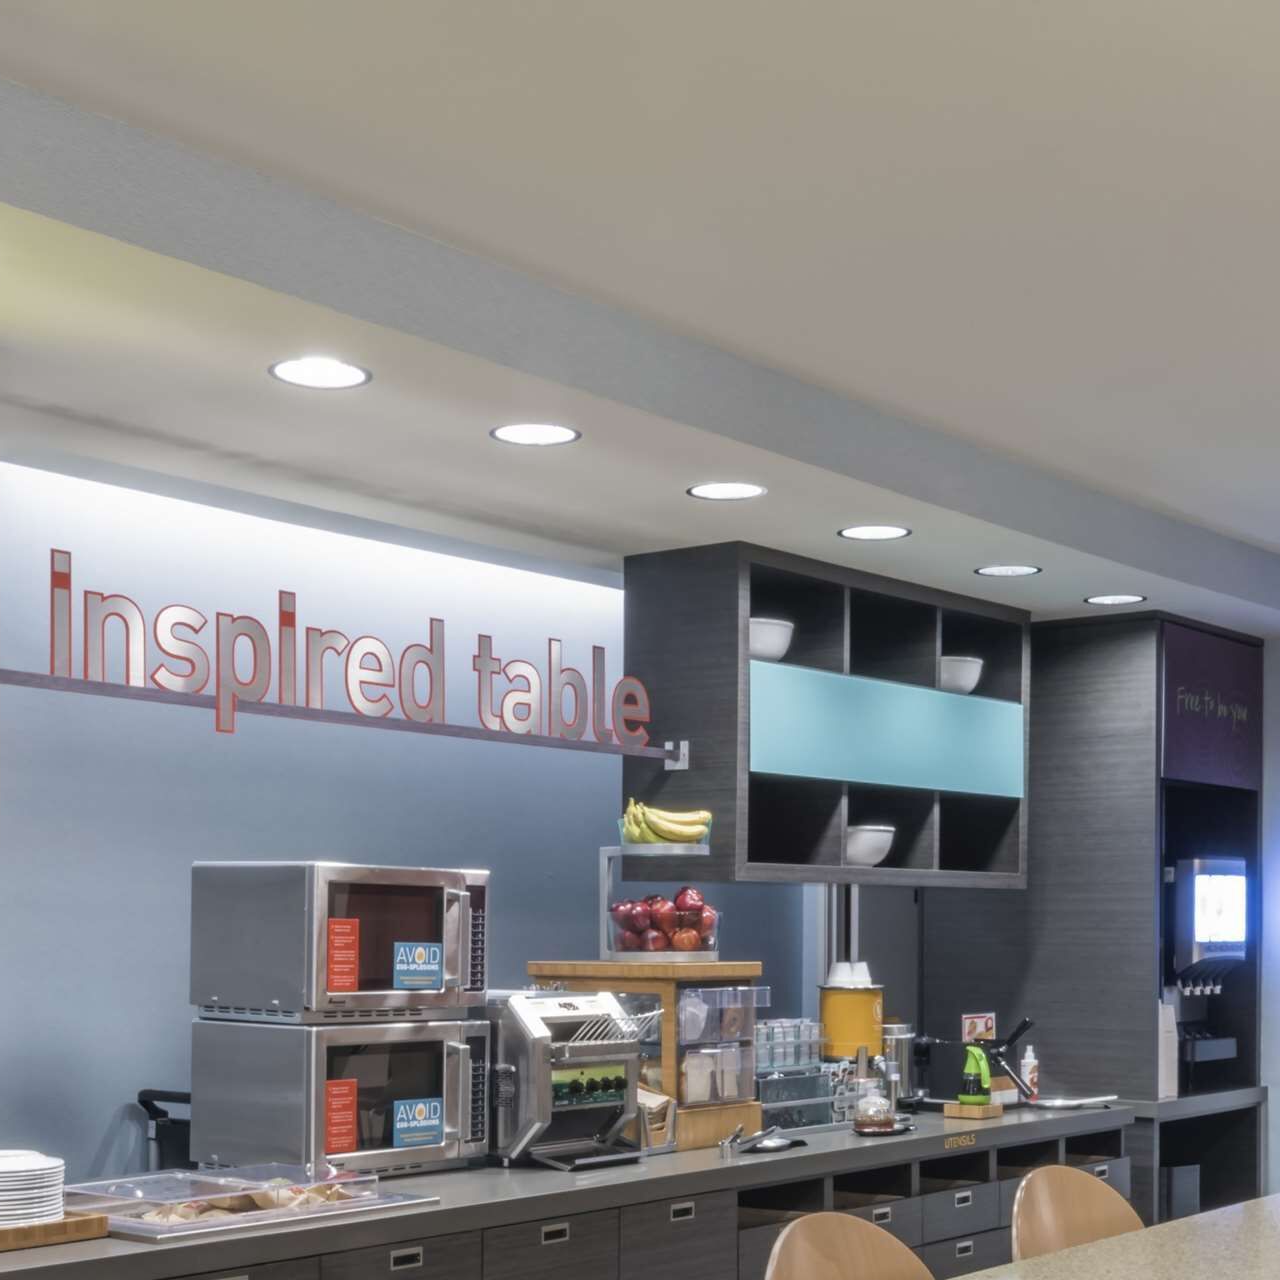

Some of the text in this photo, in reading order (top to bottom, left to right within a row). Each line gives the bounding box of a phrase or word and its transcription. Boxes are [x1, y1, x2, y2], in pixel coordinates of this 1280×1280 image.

[49, 547, 652, 748] inspired table
[396, 946, 440, 964] AVOID
[396, 1101, 441, 1121] AVOID
